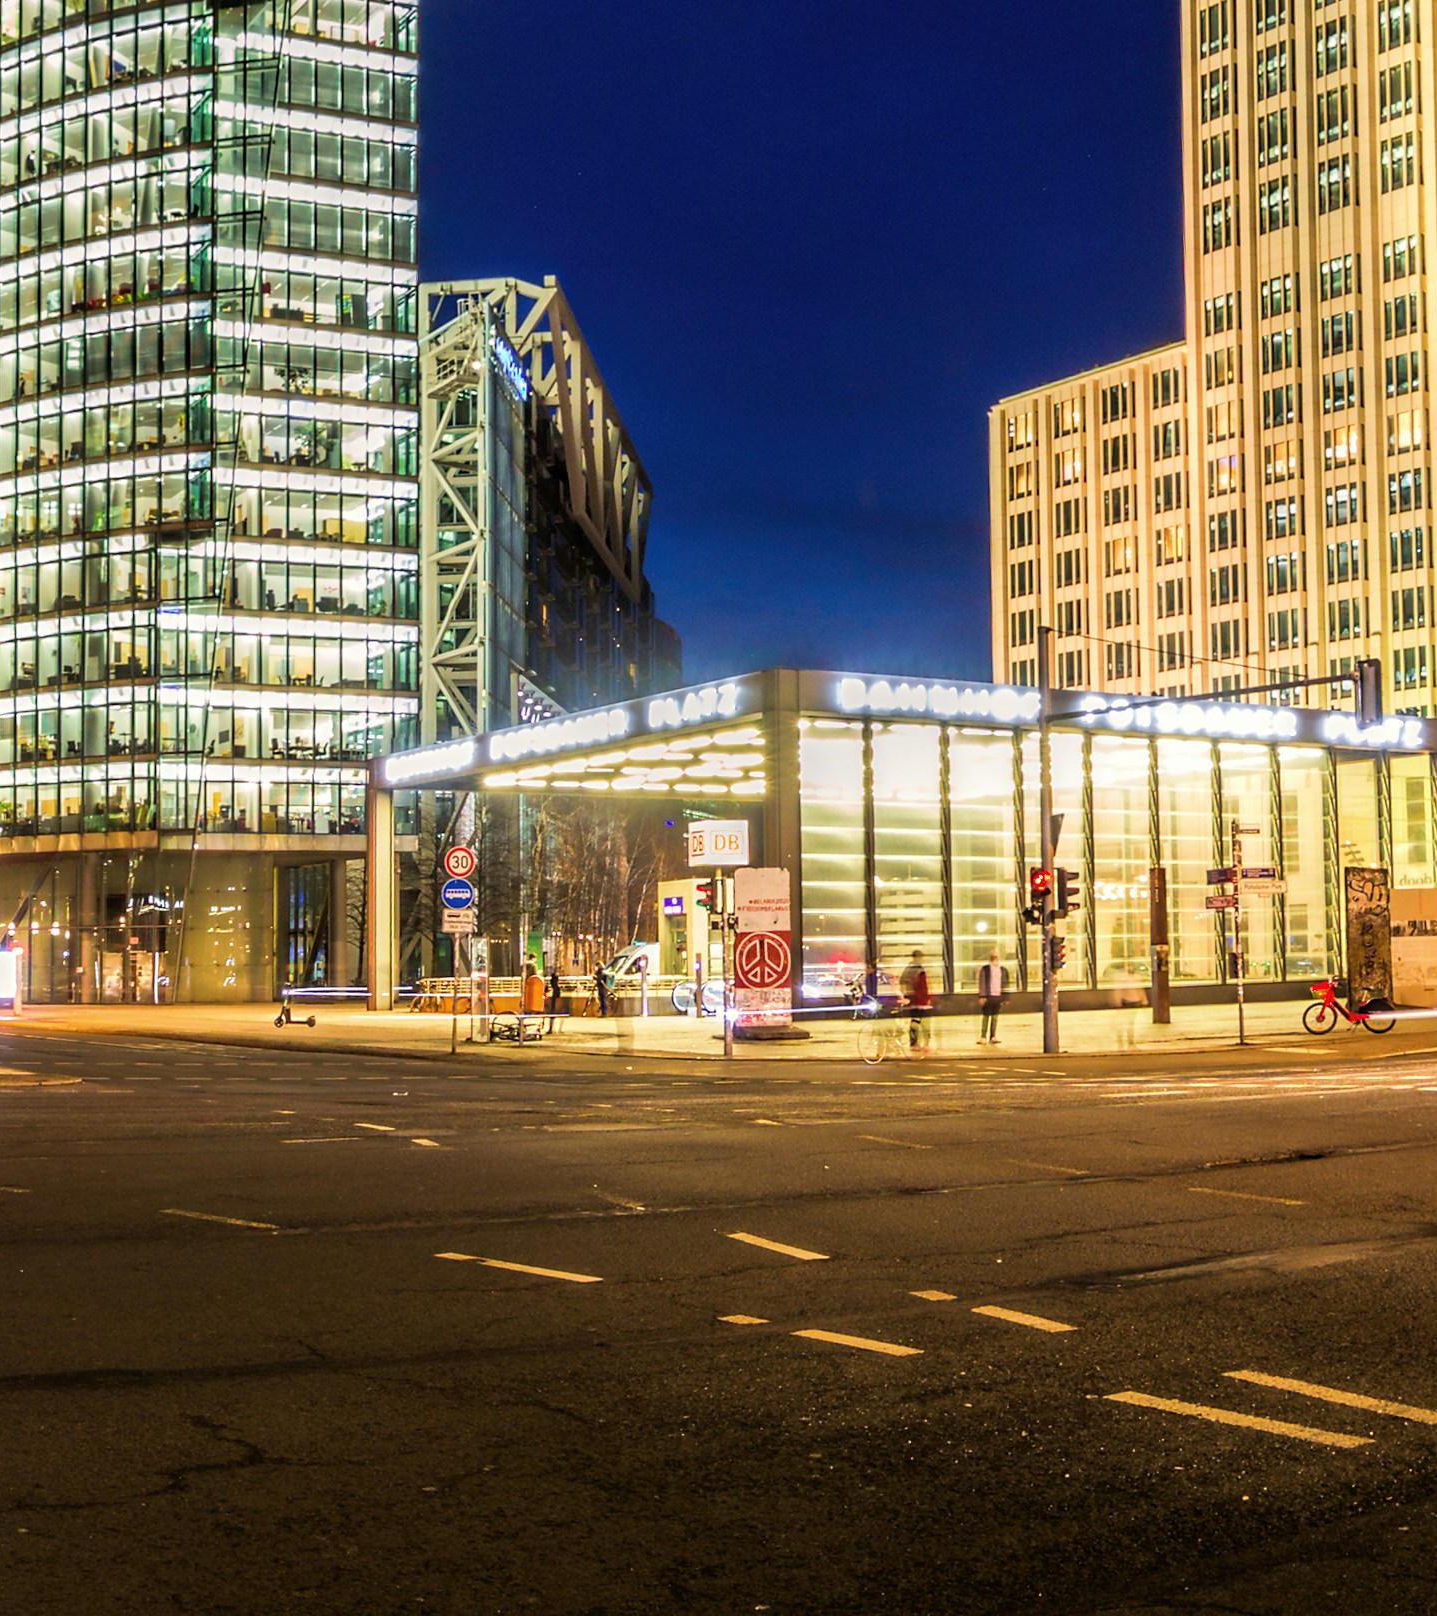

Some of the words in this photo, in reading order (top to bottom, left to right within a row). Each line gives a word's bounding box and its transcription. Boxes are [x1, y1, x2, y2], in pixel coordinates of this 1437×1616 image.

[692, 835, 704, 852] DB
[714, 834, 740, 851] DB
[451, 855, 469, 869] 30
